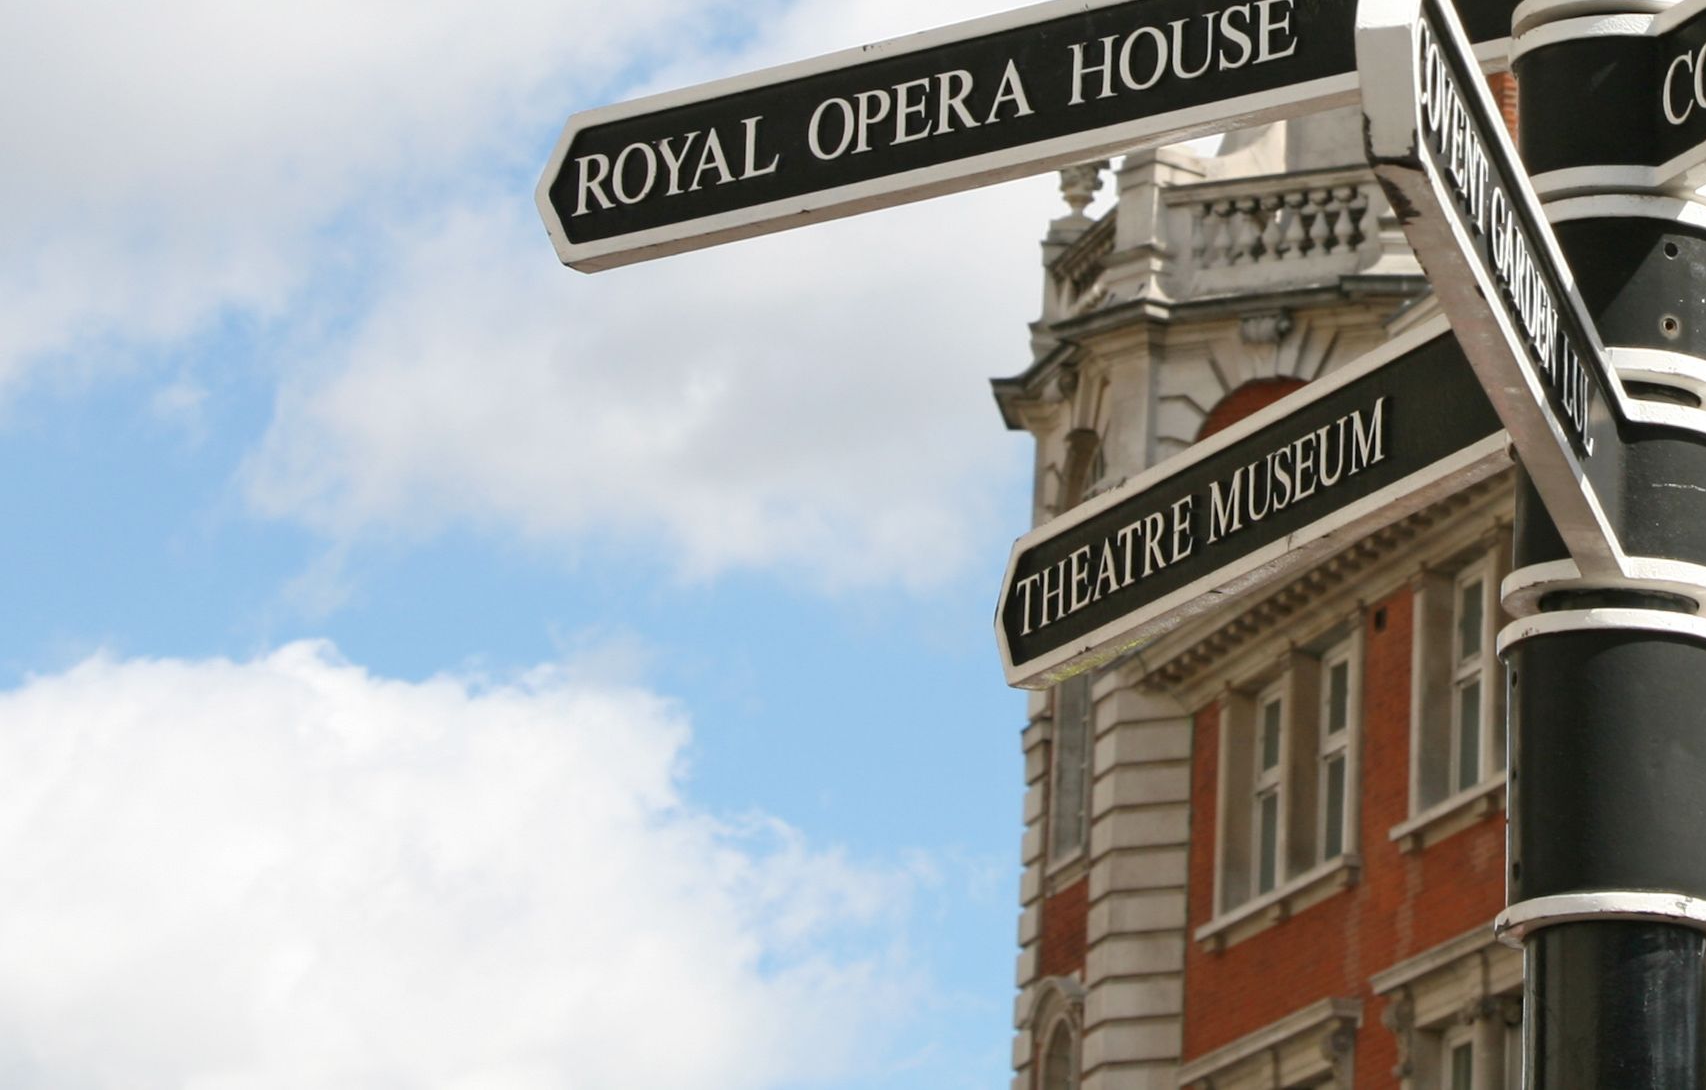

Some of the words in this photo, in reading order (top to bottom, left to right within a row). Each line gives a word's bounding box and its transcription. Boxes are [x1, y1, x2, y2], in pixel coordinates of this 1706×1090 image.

[571, 115, 779, 217] ROYAL
[807, 58, 1033, 161] OPERA
[1418, 17, 1489, 235] COVENT
[1490, 186, 1558, 387] GARDEN
[1016, 494, 1193, 636] THEATRE
[1206, 396, 1387, 545] MUSEUM
